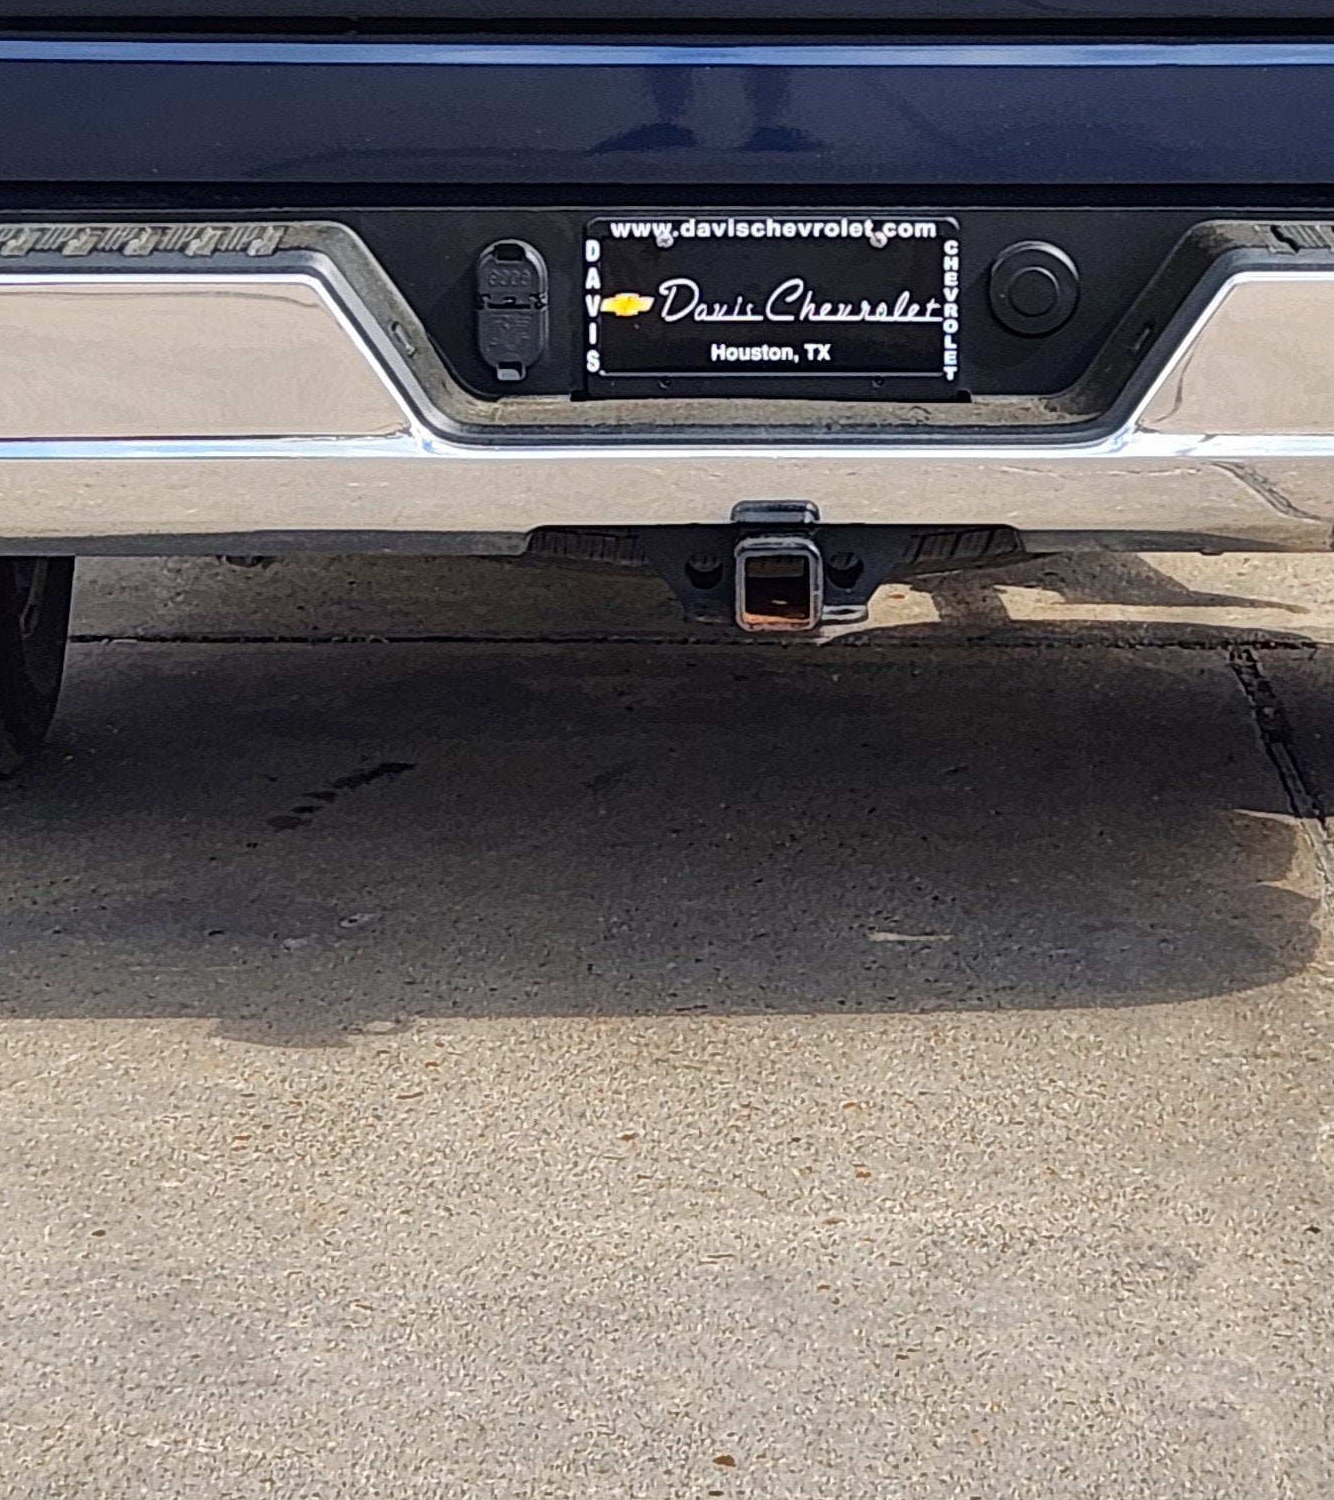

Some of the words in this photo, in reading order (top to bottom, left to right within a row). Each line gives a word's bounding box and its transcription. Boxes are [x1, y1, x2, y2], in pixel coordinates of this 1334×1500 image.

[610, 218, 937, 238] www.davischevroletcom
[585, 239, 601, 373] DAVIS
[658, 278, 764, 322] Davis
[765, 278, 943, 322] Chevrolet
[942, 239, 959, 381] CHEVROLET
[710, 343, 800, 363] Houston,
[803, 343, 832, 362] TX
